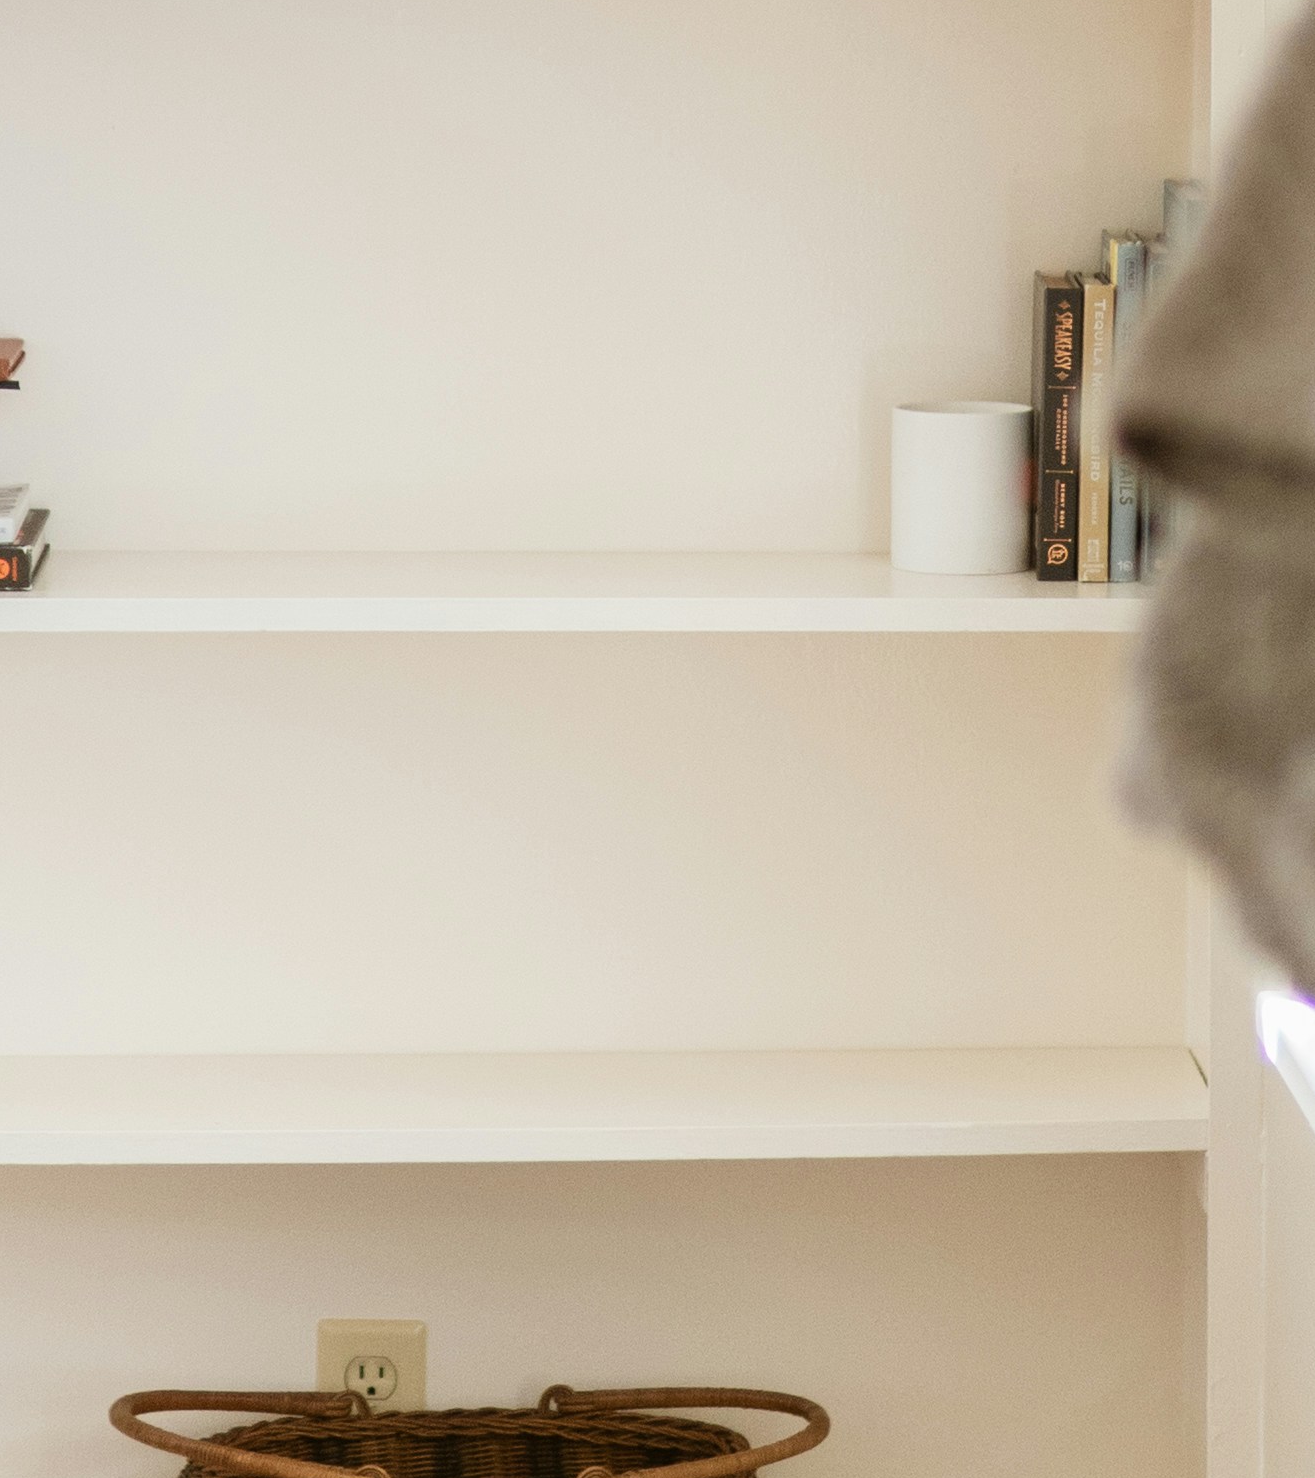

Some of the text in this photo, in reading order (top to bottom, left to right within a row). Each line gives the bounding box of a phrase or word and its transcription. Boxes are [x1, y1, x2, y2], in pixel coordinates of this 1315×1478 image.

[1053, 310, 1074, 372] SPEAKEASY
[1089, 298, 1108, 482] TEQUILA MONGBIRD
